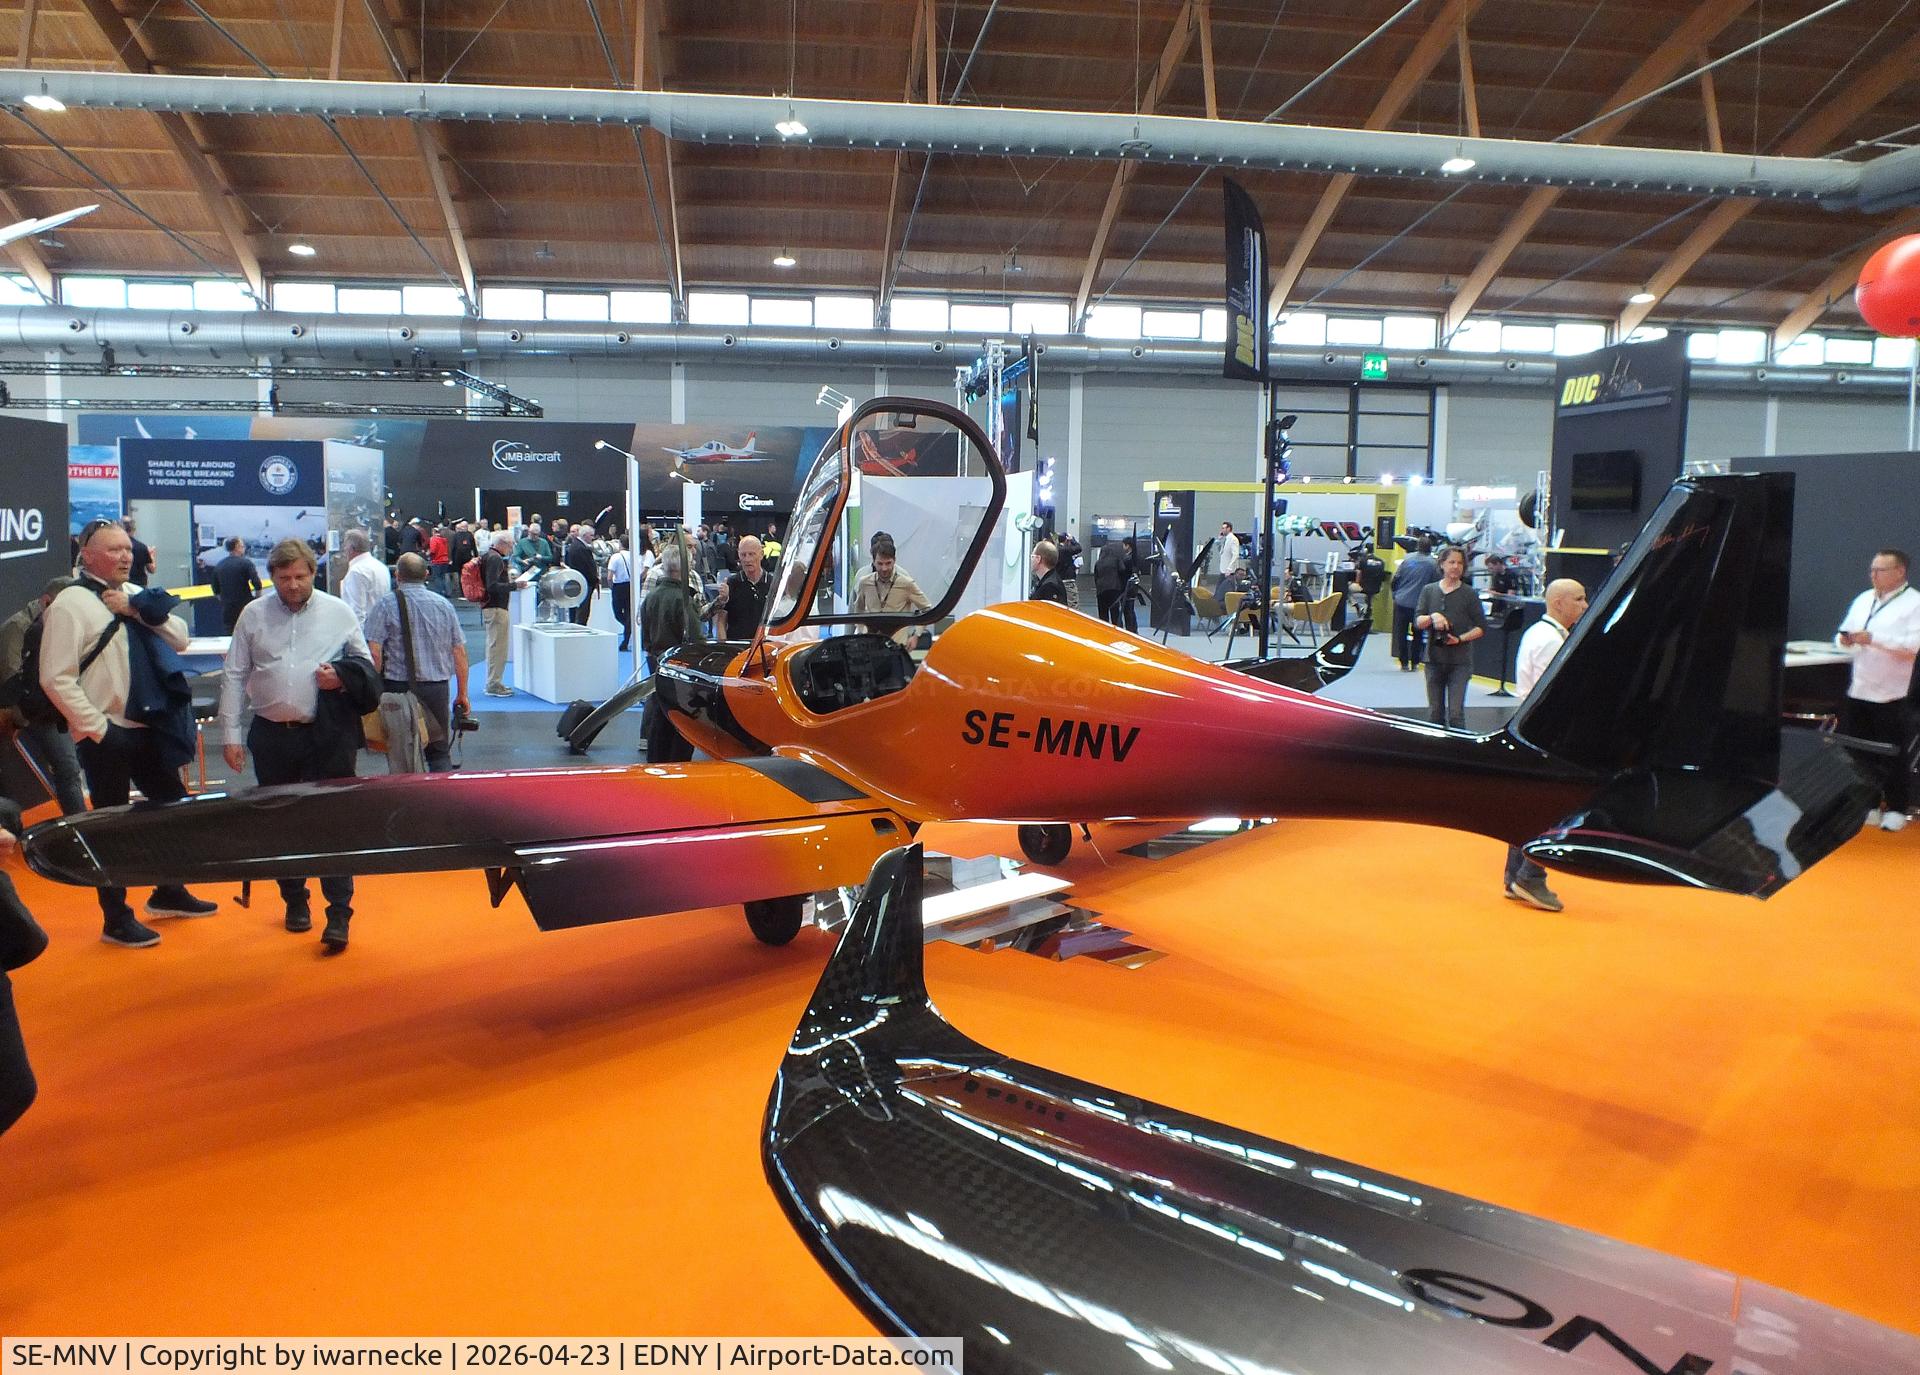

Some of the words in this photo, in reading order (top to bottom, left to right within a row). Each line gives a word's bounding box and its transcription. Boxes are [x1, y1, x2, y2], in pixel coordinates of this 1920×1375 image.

[1561, 374, 1600, 406] DUC
[502, 452, 522, 461] JMB
[524, 451, 561, 462] aircraft
[148, 460, 175, 468] SHARK
[176, 460, 199, 469] FLEW
[200, 461, 236, 469] AROUND
[148, 469, 164, 477] THE
[165, 469, 192, 477] GLOBE
[193, 470, 235, 478] BREAKING
[155, 478, 186, 486] WORLD
[187, 479, 225, 487] RECORDS
[0, 508, 43, 541] ING
[961, 709, 1140, 762] SE-MNV
